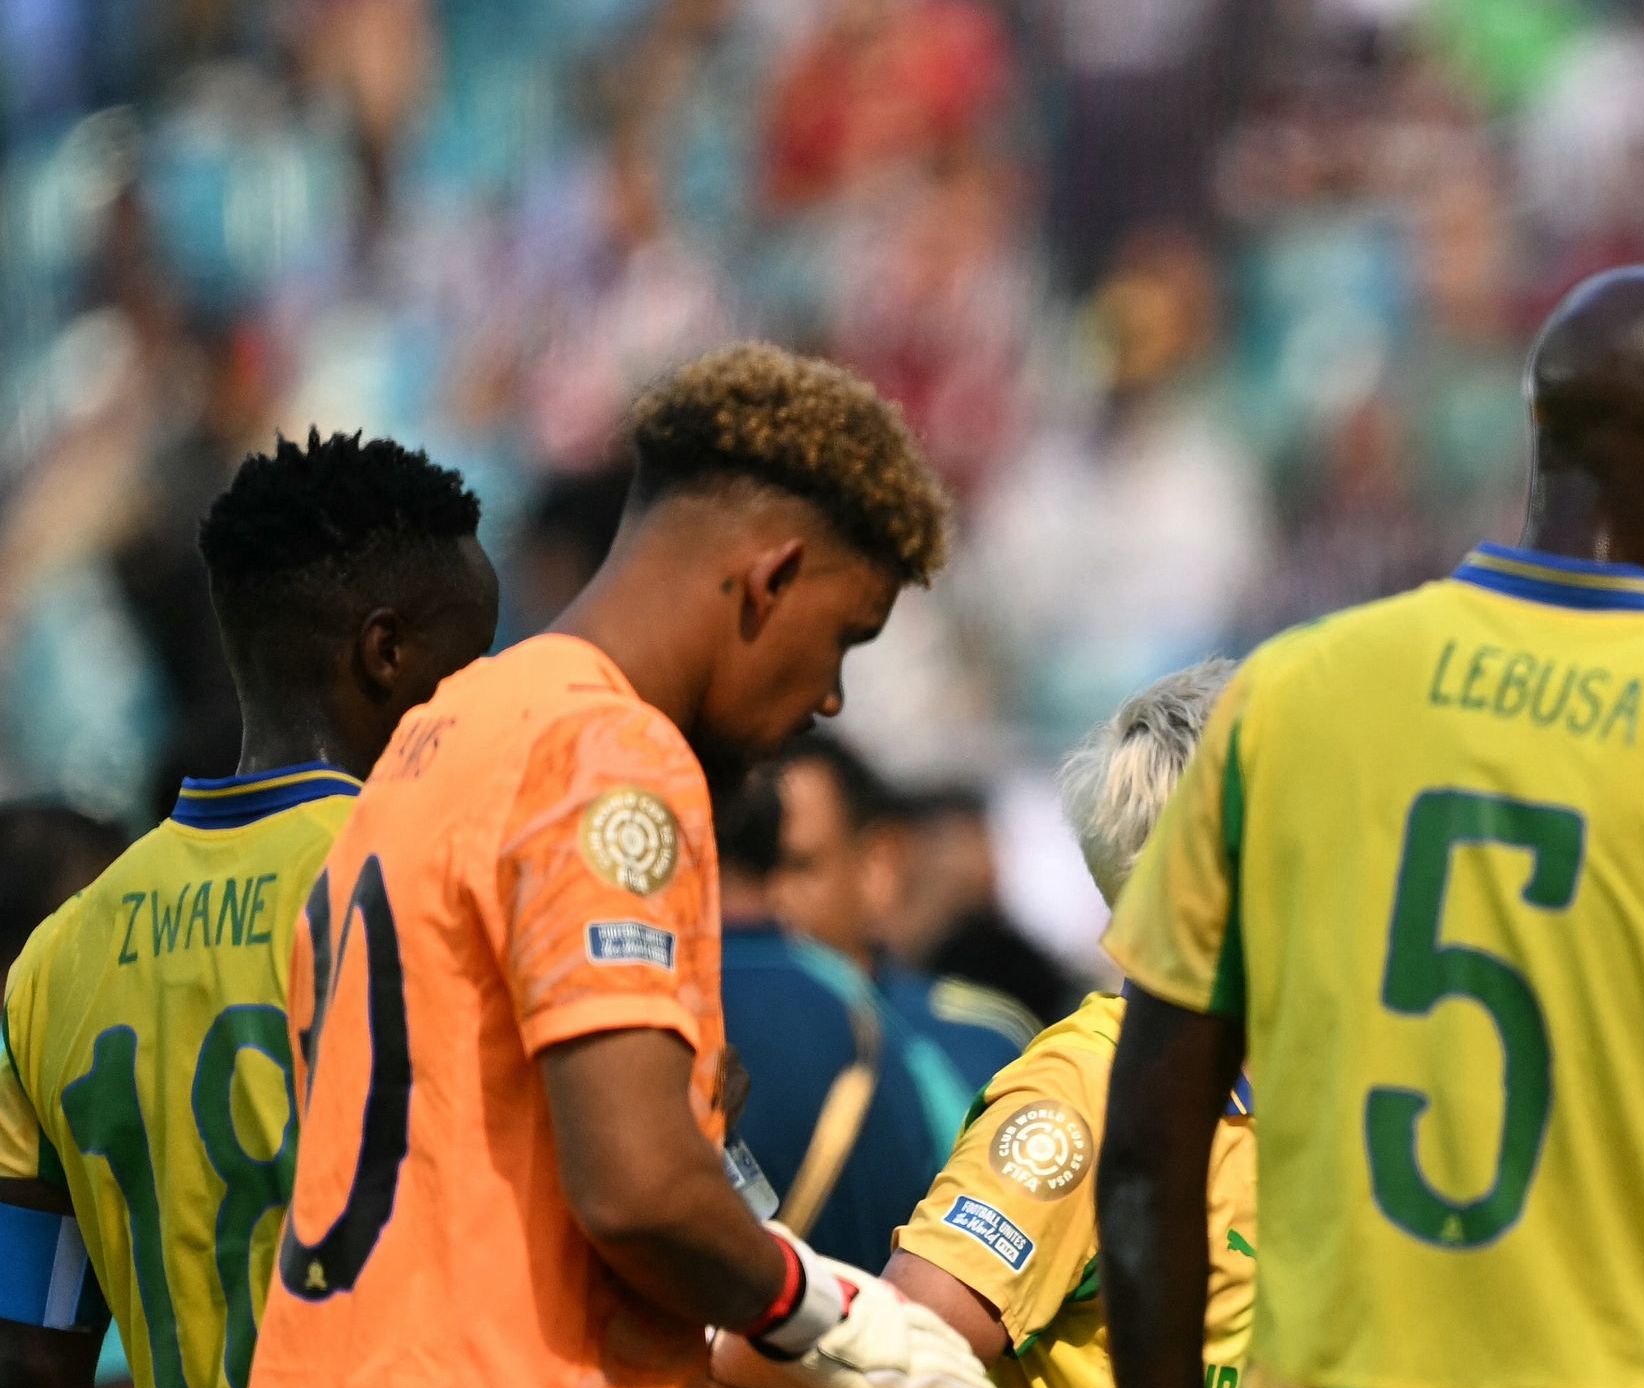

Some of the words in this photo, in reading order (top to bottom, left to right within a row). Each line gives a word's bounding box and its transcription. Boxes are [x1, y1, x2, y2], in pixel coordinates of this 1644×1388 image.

[1429, 640, 1643, 746] LEBUSA
[117, 872, 278, 967] ZWANE
[1364, 785, 1586, 1253] 5
[998, 1125, 1016, 1157] CLUB
[1015, 1109, 1066, 1126] WORLD
[1001, 1161, 1040, 1193] FIFA
